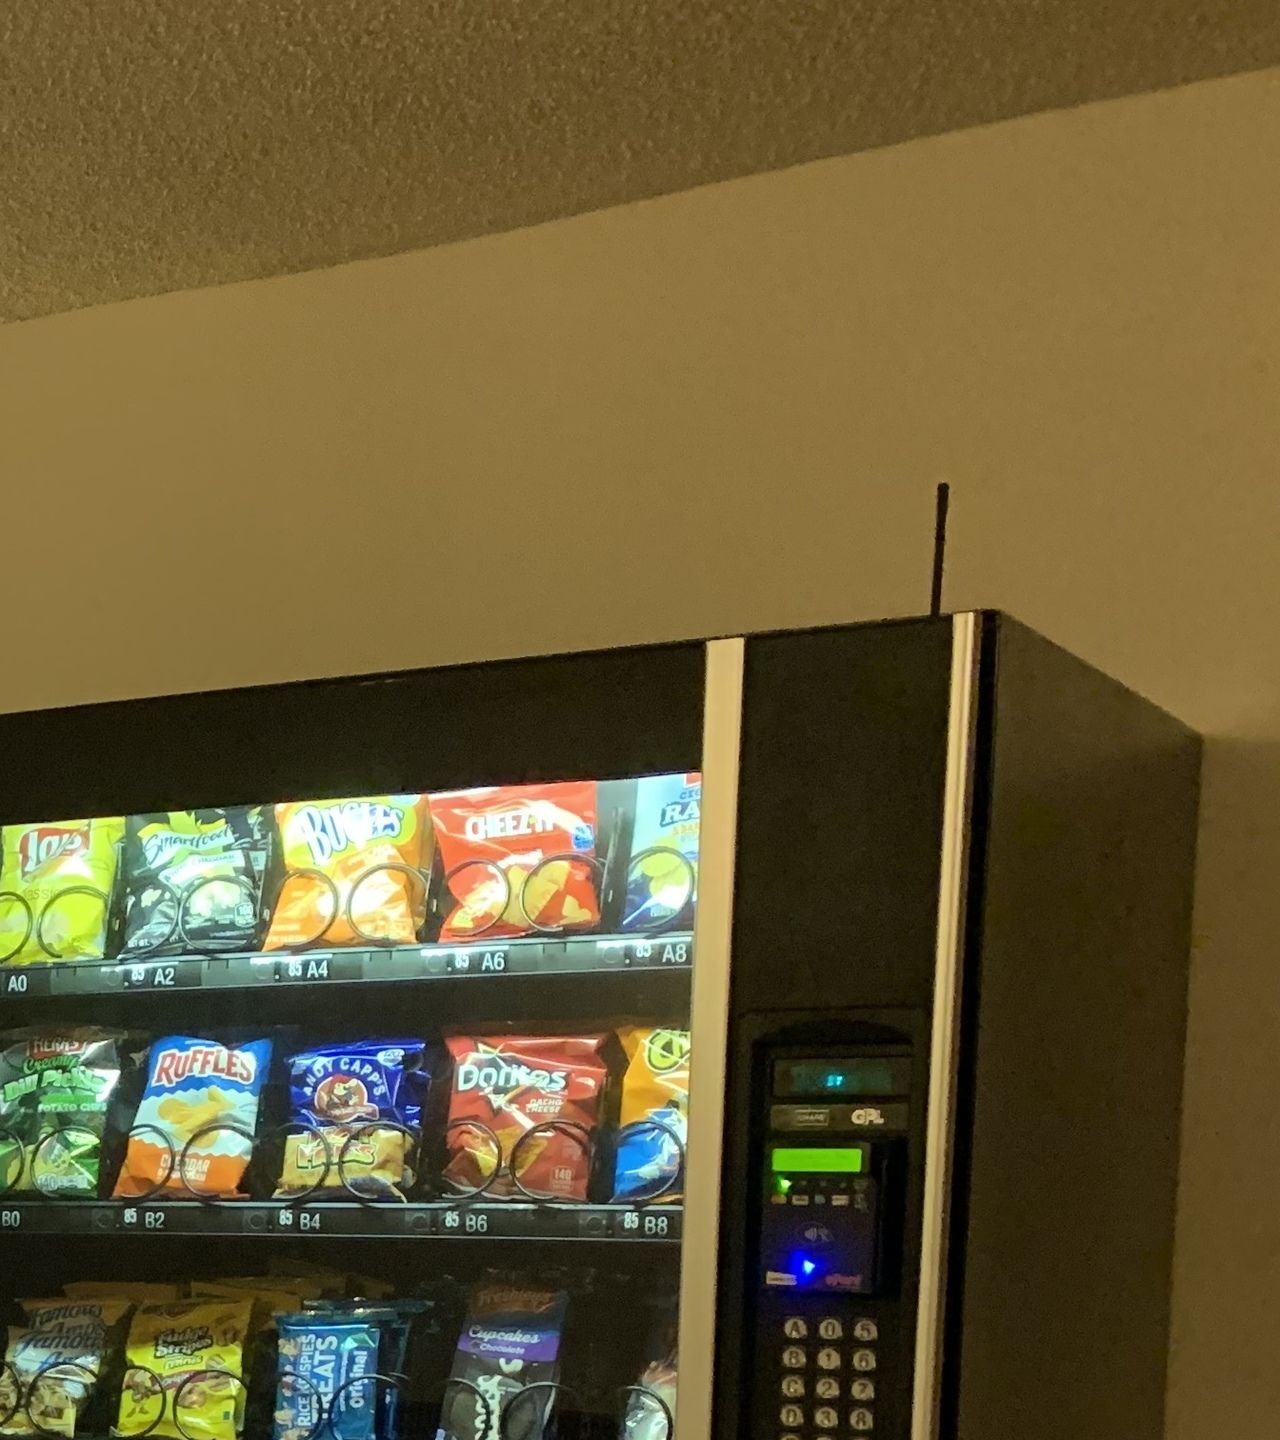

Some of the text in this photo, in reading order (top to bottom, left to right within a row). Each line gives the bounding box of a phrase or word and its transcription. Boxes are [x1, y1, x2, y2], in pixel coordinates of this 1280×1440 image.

[481, 952, 505, 971] A6
[662, 944, 688, 963] A8
[154, 968, 176, 985] A2
[307, 960, 329, 978] A4
[8, 975, 28, 993] A0
[153, 1047, 256, 1085] RUFFLES
[303, 1058, 334, 1096] ANDY
[457, 1064, 568, 1093] Doritos
[38, 1103, 77, 1113] POTATO
[2, 1211, 21, 1228] B0
[145, 1211, 165, 1229] B2
[300, 1213, 321, 1230] B4
[465, 1214, 488, 1232] B6
[645, 1216, 668, 1234] B8
[468, 1325, 540, 1345] Cupcakes
[479, 1343, 525, 1355] Chocolate
[297, 1397, 312, 1426] RICE
